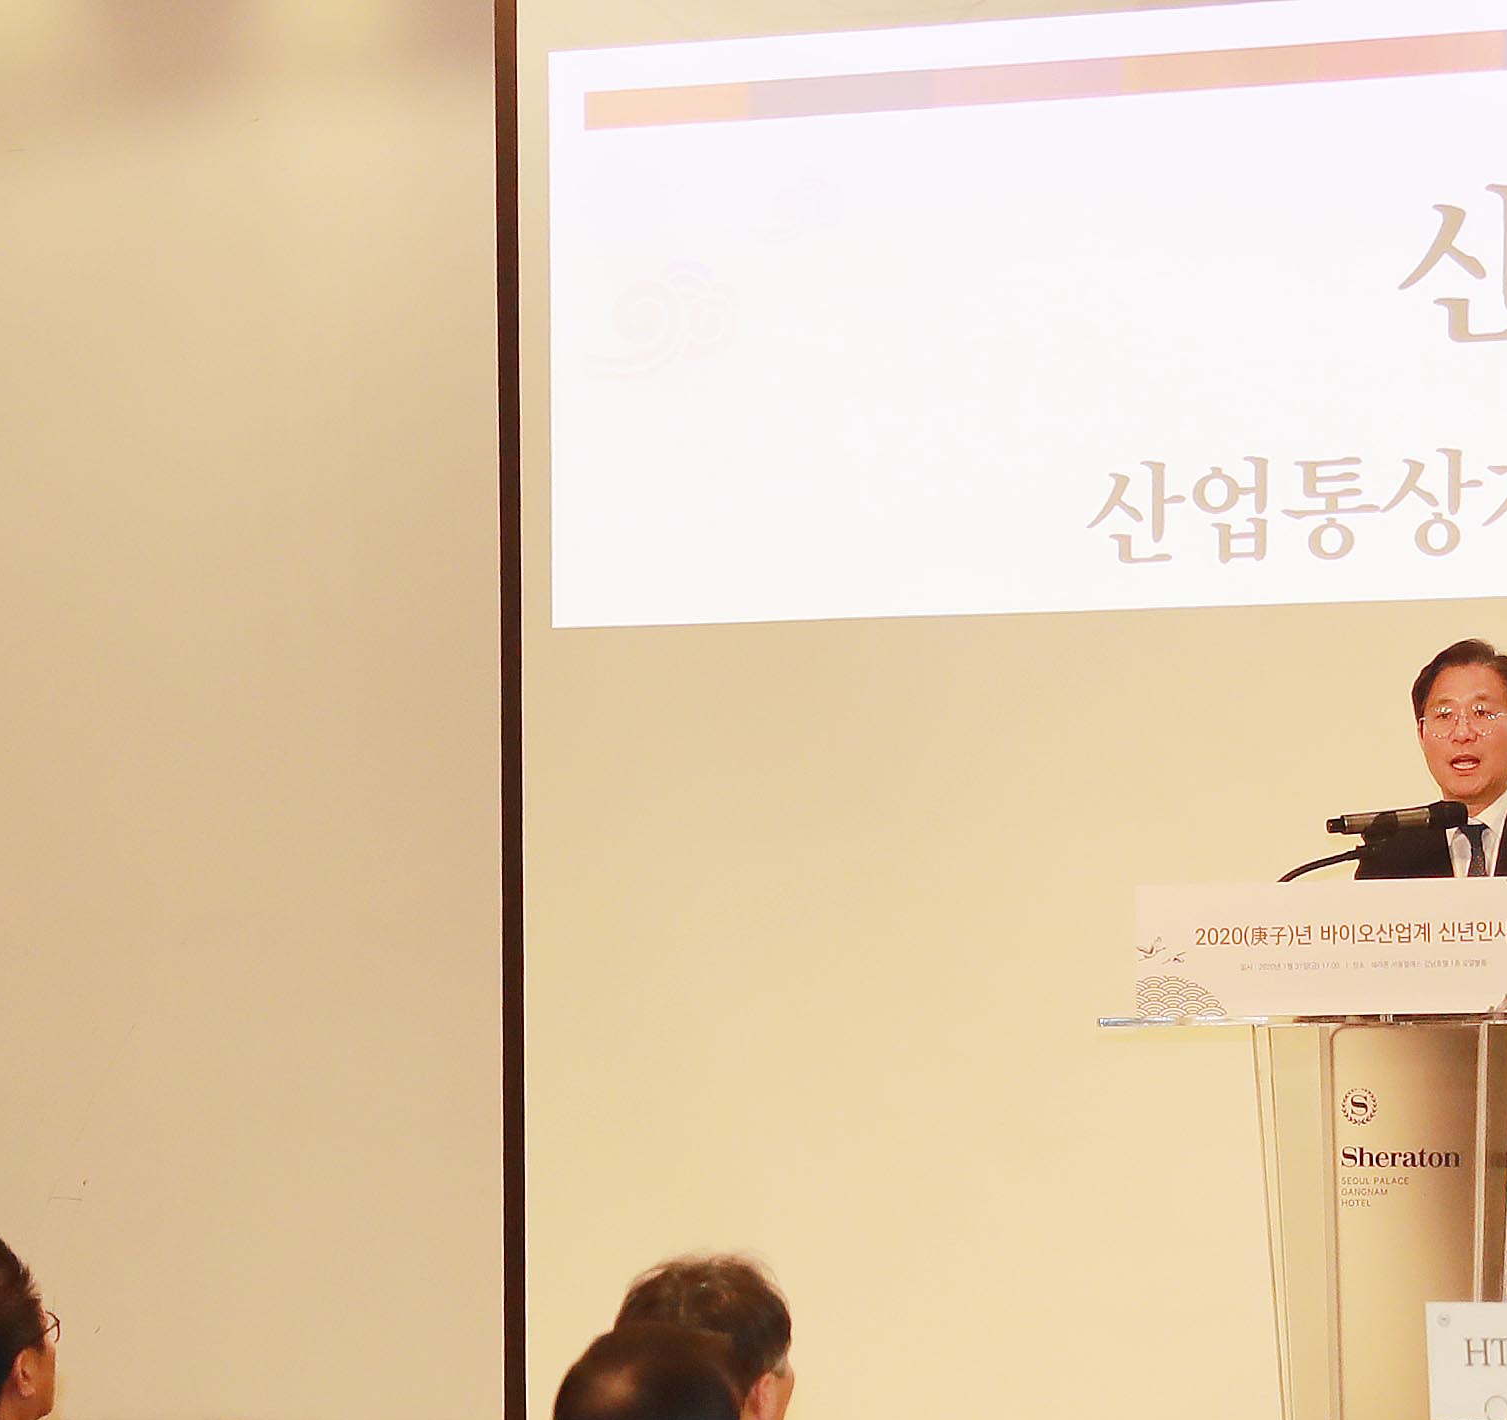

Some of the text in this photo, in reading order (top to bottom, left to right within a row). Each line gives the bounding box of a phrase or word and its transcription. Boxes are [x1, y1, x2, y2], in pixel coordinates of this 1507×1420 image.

[1196, 925, 1311, 946] 2020(庚子)년
[1321, 923, 1430, 944] 바이오산업계
[1341, 1146, 1460, 1168] Sheraton
[1341, 1177, 1410, 1185] SEOUL PALACE
[1341, 1188, 1388, 1196] GANGNAM
[1340, 1199, 1372, 1207] HOTEL
